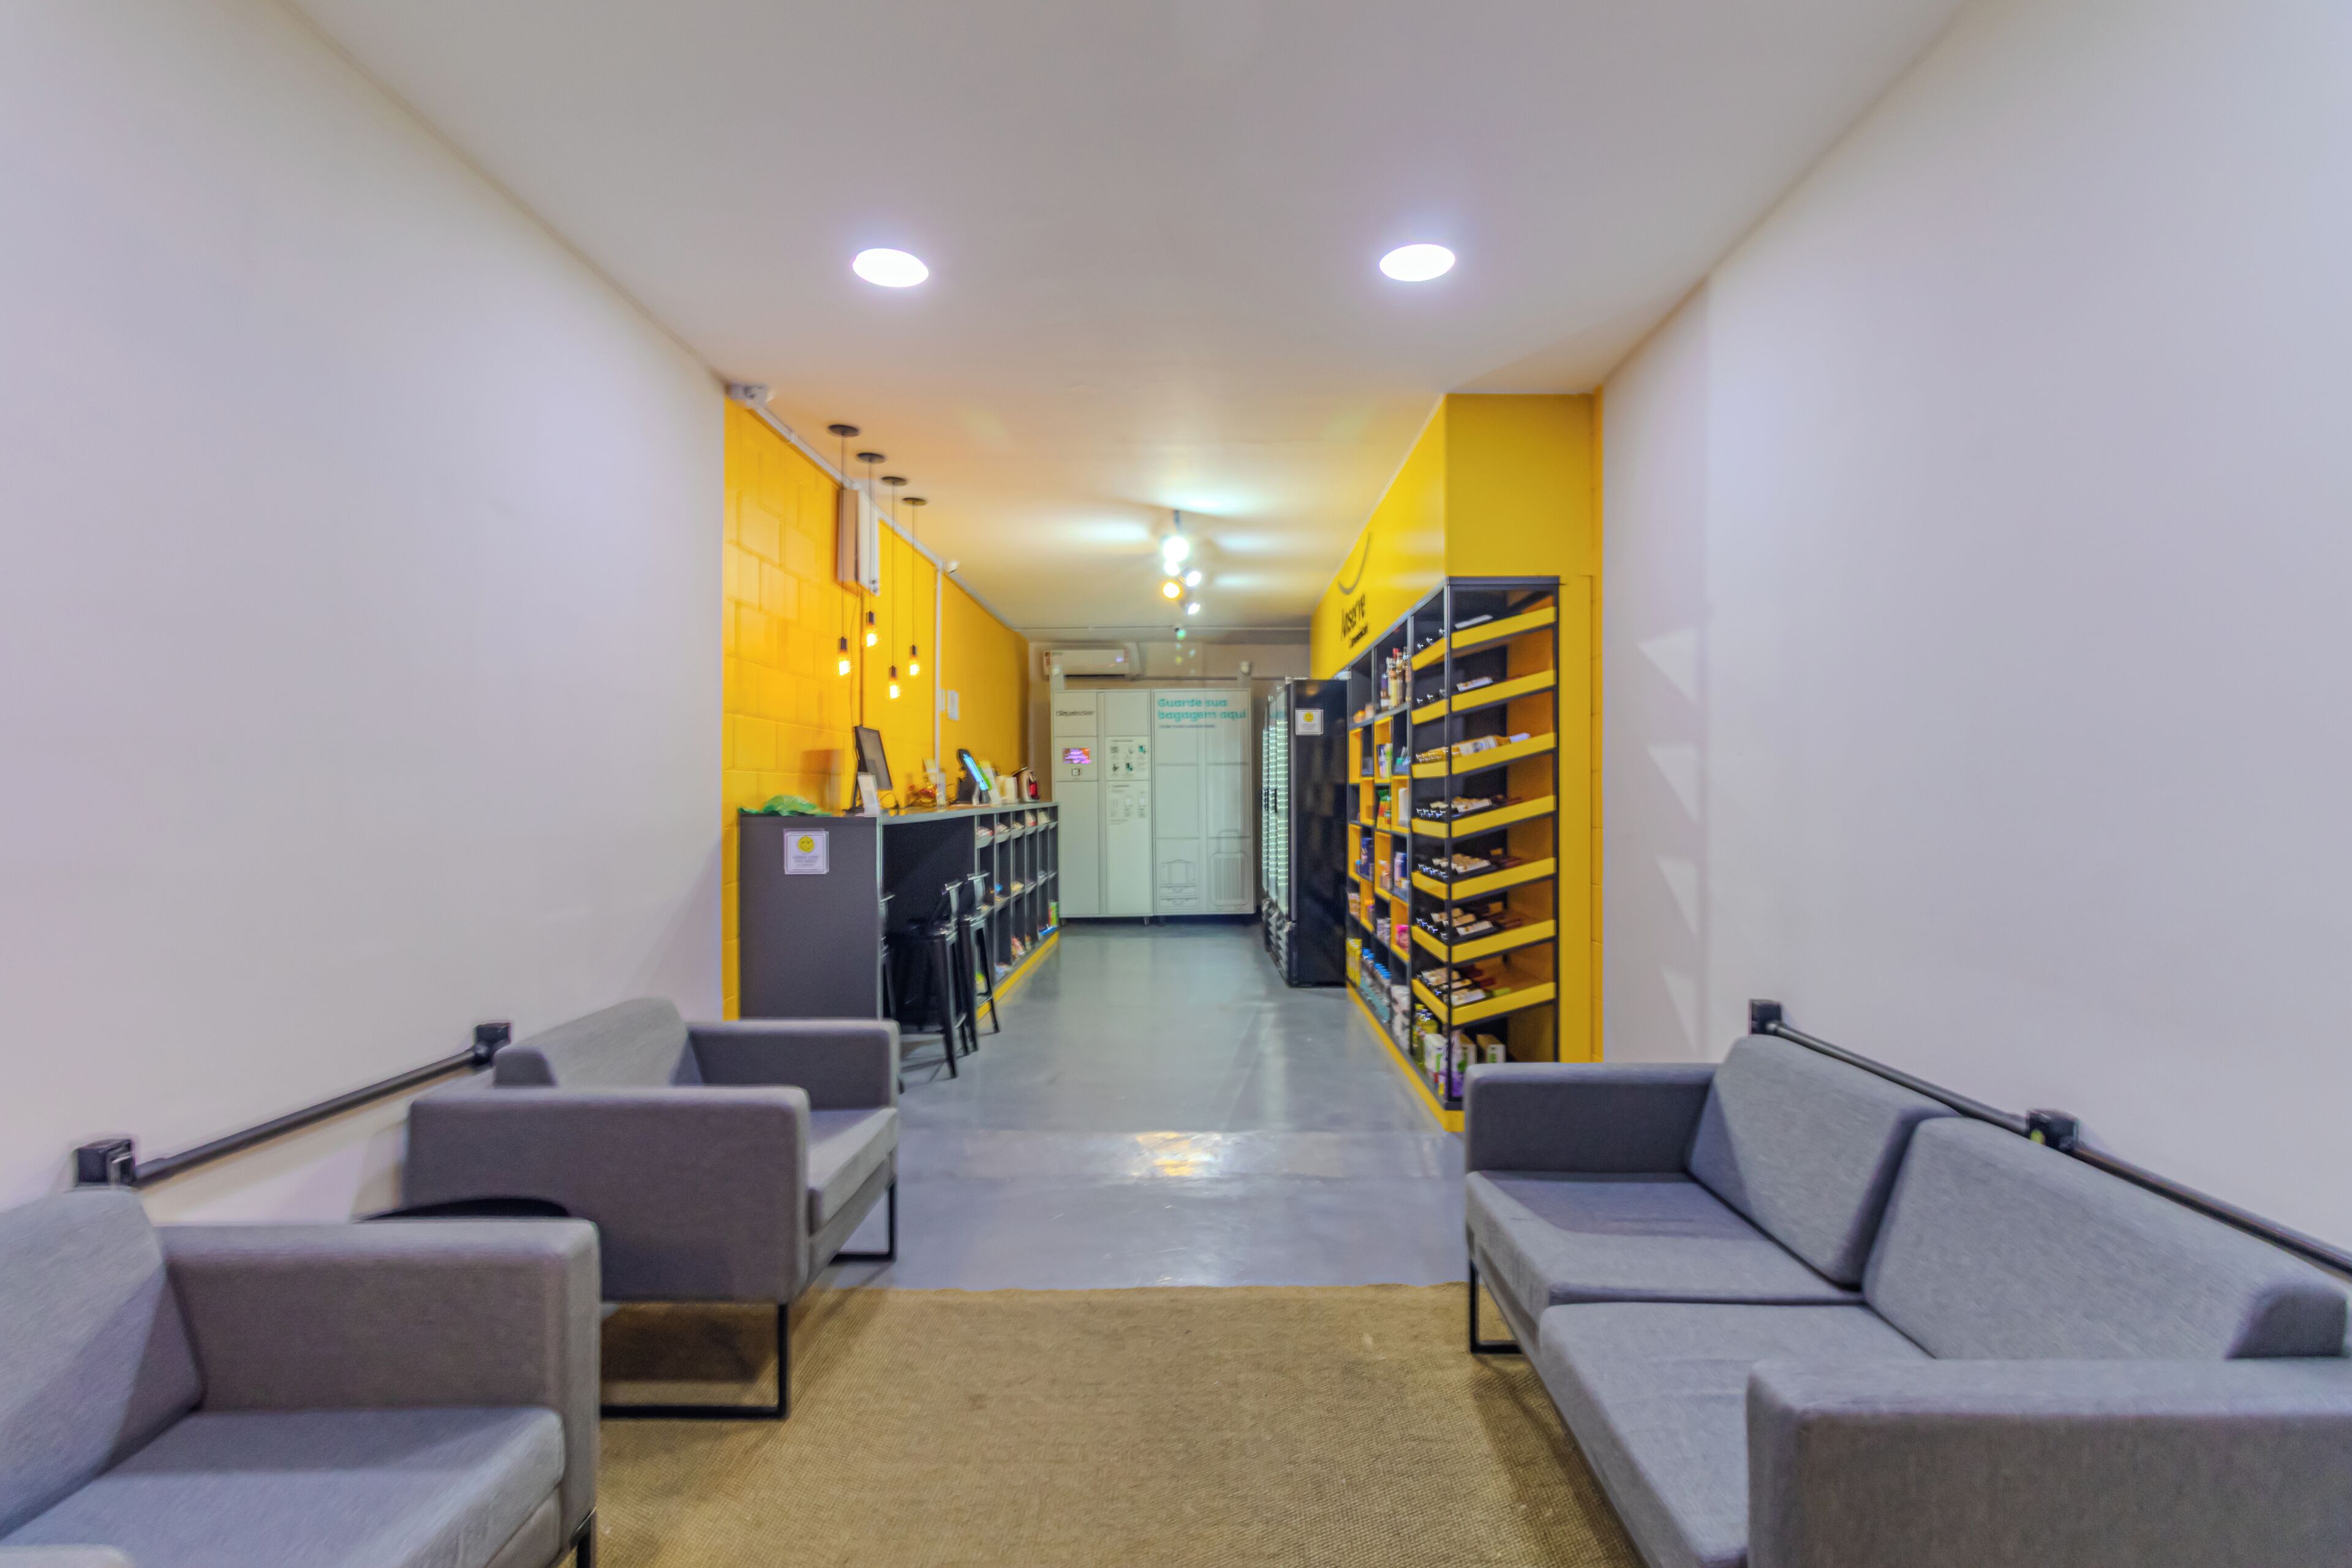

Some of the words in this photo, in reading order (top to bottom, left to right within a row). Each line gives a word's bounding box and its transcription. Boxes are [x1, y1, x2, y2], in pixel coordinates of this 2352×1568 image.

[1158, 698, 1202, 707] Guarde
[1158, 710, 1216, 722] bagagem
[1219, 709, 1246, 722] aqui
